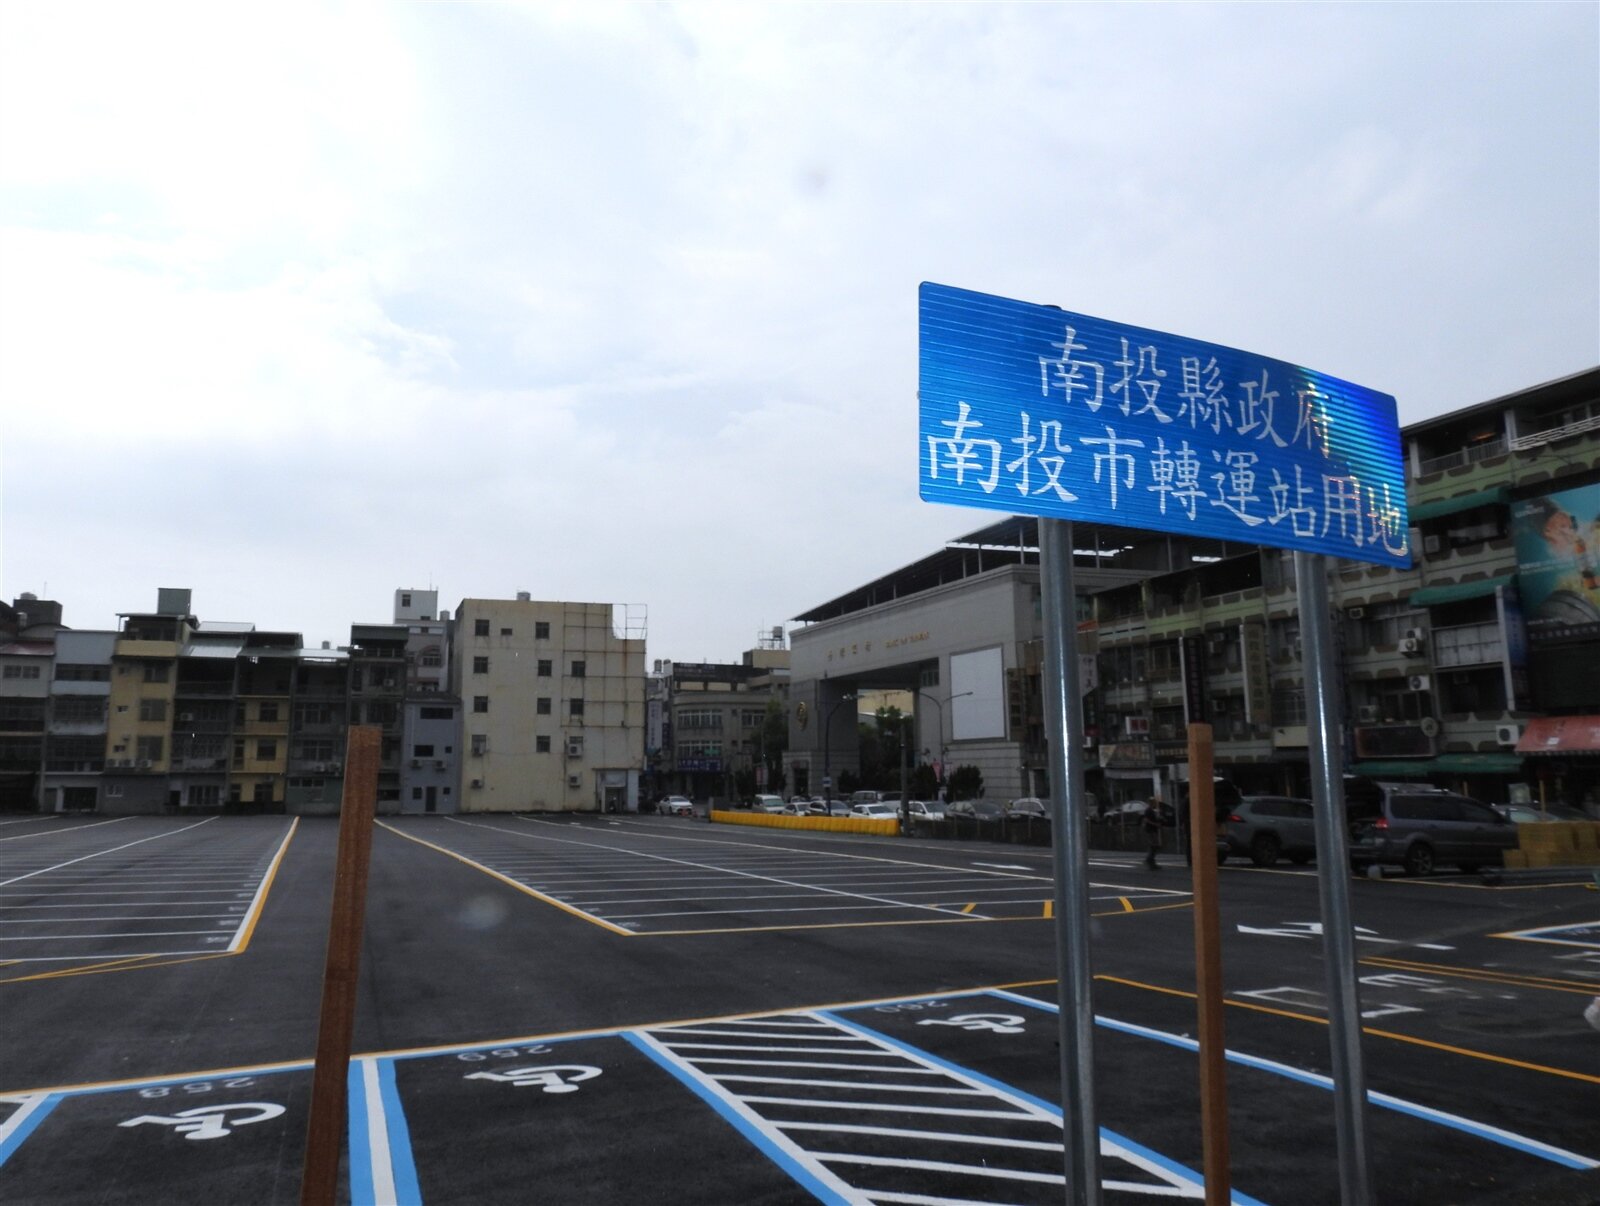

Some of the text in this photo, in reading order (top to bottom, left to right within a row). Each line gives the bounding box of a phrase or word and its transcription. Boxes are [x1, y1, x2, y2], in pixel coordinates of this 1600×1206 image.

[1038, 325, 1334, 459] 南投縣政府
[927, 400, 1408, 557] 南投市轉運站用地
[138, 1076, 256, 1099] 258
